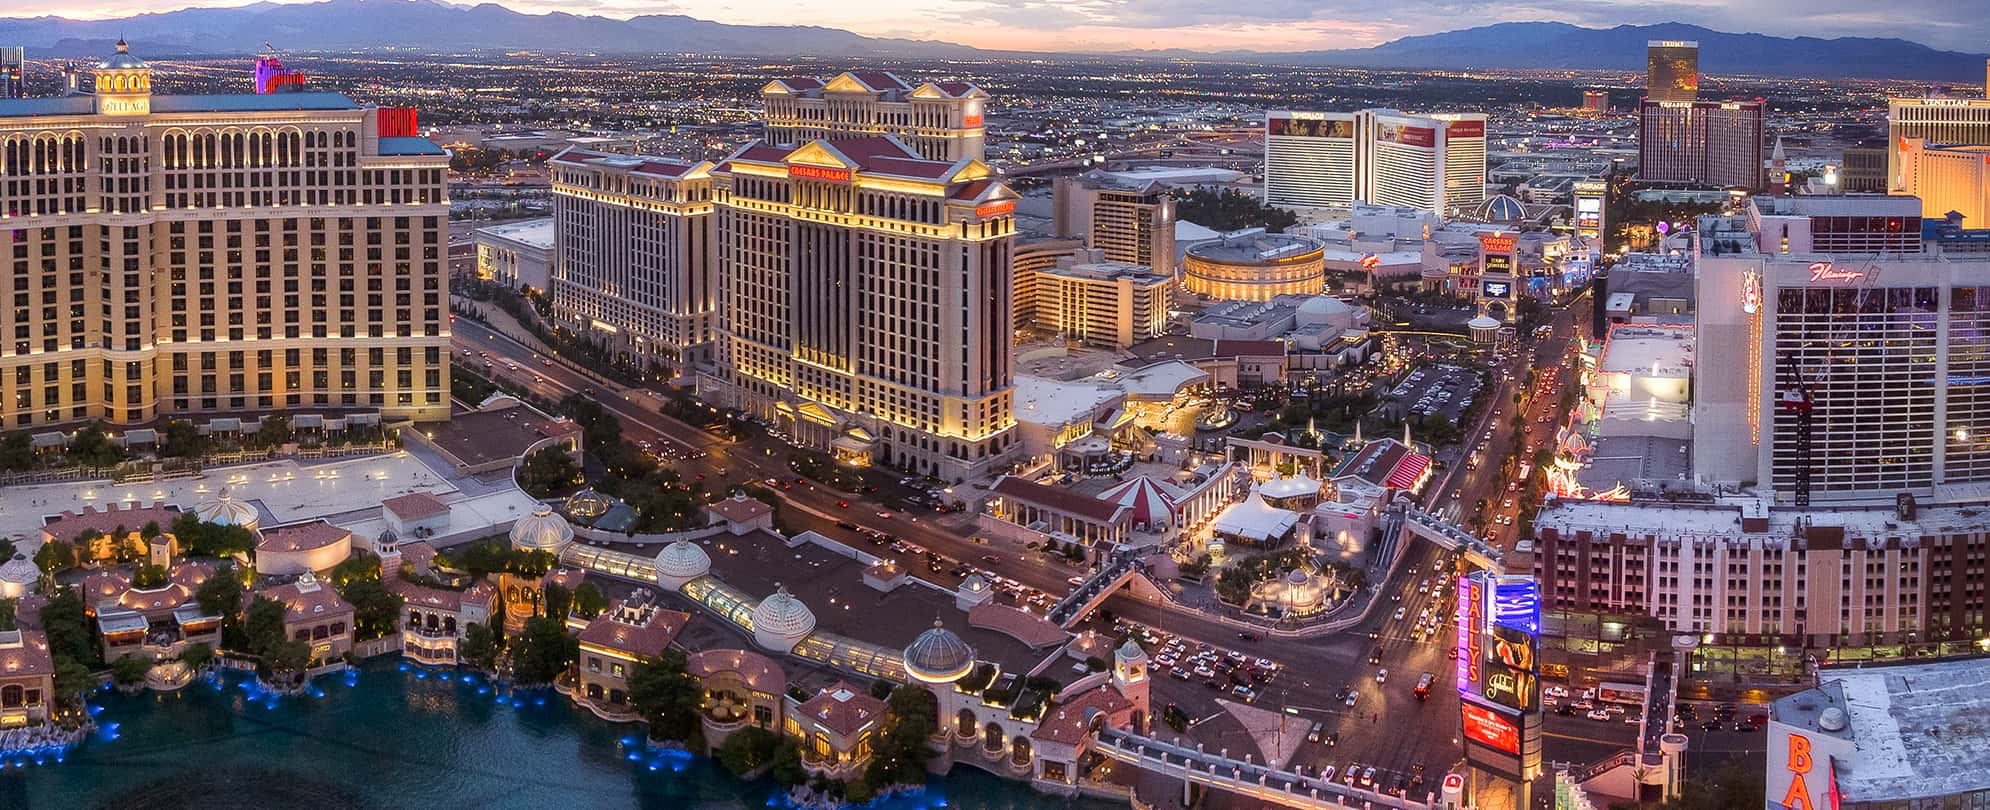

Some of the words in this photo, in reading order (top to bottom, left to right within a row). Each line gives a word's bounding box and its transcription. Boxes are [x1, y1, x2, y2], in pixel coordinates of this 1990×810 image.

[791, 166, 820, 178] CAESARS
[821, 169, 849, 181] PALACE
[1808, 262, 1864, 282] Flamingo
[1782, 733, 1814, 810] BA
